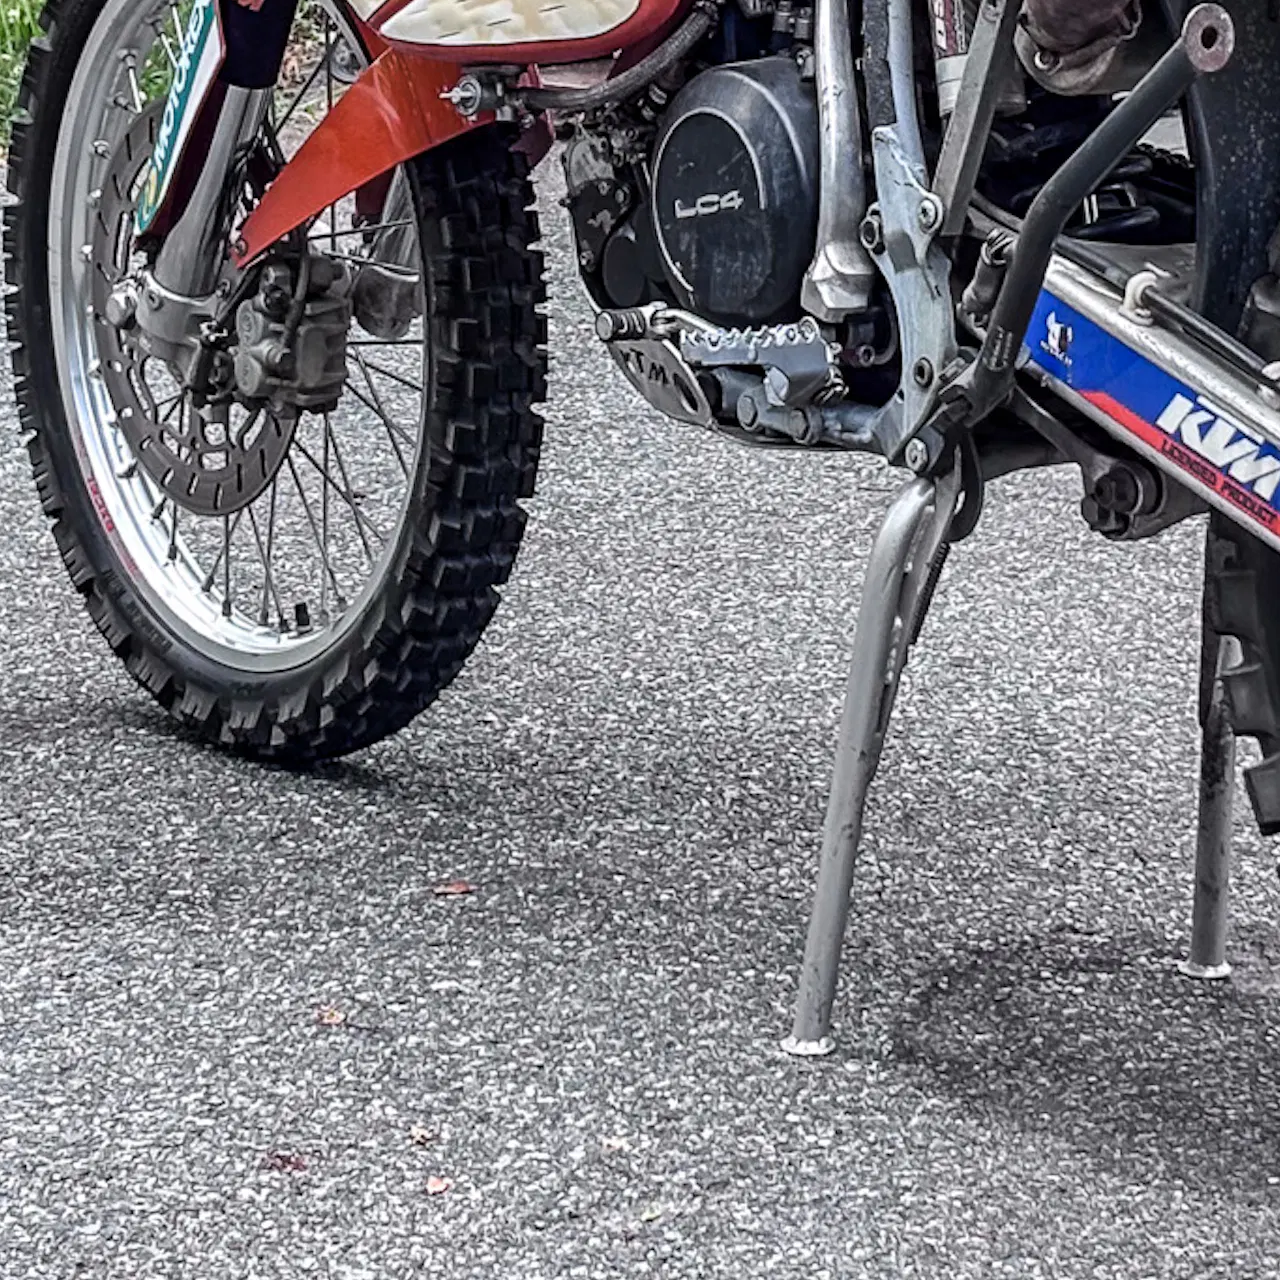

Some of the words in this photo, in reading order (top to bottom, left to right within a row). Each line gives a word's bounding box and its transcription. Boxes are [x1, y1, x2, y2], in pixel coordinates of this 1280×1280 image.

[673, 189, 744, 219] LC4
[1161, 439, 1217, 487] LICENSED
[1219, 479, 1279, 524] PRODUCT
